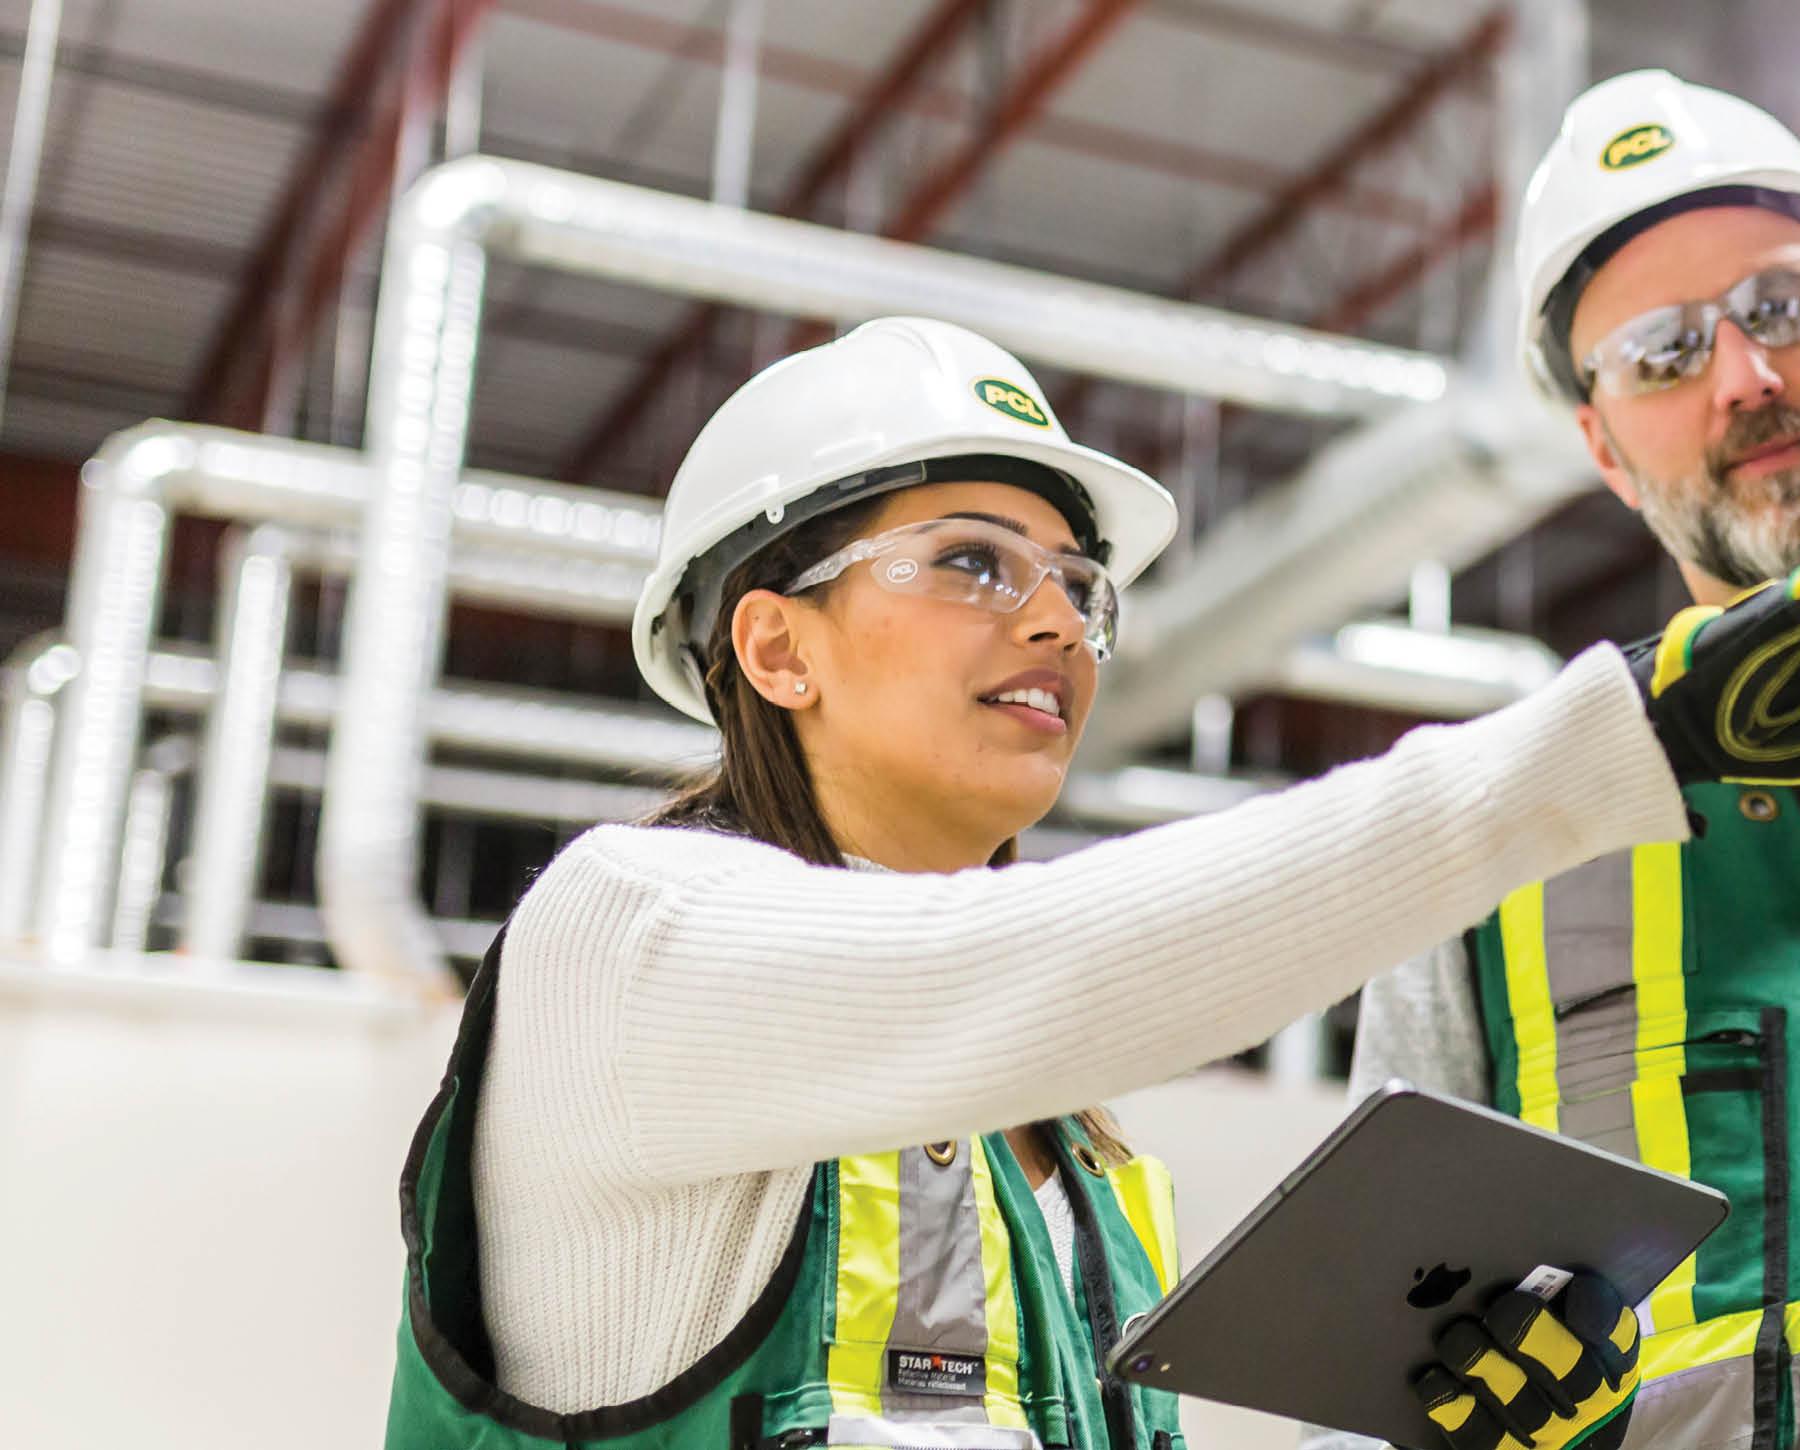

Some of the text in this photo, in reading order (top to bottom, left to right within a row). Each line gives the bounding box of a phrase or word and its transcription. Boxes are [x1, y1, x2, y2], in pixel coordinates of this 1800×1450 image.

[1609, 129, 1669, 164] PCL
[985, 384, 1044, 422] PCL
[899, 1355, 932, 1370] STAR
